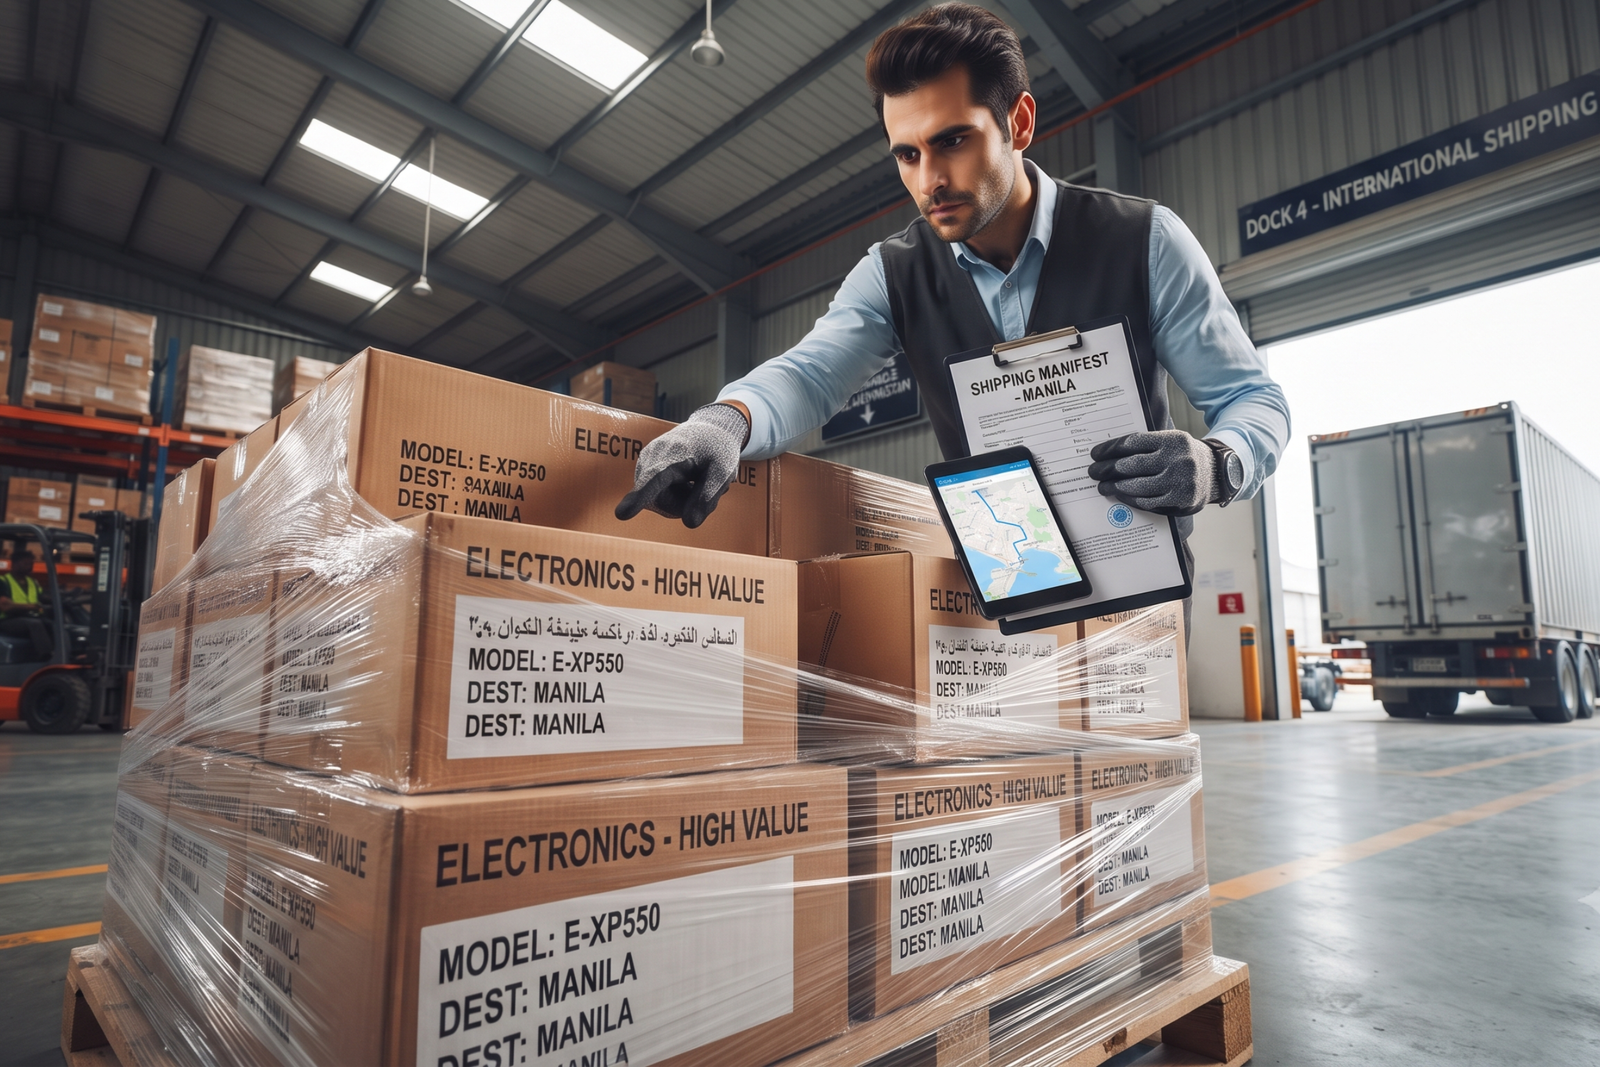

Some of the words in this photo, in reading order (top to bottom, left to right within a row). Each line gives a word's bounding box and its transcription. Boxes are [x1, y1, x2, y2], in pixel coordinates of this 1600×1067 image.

[1245, 204, 1294, 240] DOCK
[1295, 199, 1307, 220] 4
[1322, 138, 1479, 212] INTERNATIONAL
[1483, 91, 1599, 153] SHIPPING
[970, 369, 1035, 396] SHIPPING
[1039, 351, 1109, 381] MANIFEST
[399, 464, 456, 490] DEST:
[400, 439, 474, 470] MODEL:
[479, 454, 546, 482] E-XP550
[465, 498, 522, 523] MANILA
[466, 545, 635, 592] ELECTRONICS
[654, 567, 701, 598] HIGH
[707, 572, 765, 604] VALUE
[468, 647, 546, 672] MODEL:
[552, 651, 624, 673] E-XP550
[936, 660, 971, 676] MODEL:
[467, 680, 527, 704] DEST:
[533, 681, 605, 704] MANILA
[936, 682, 964, 698] DEST:
[465, 713, 526, 738] DEST:
[532, 712, 605, 736] MANILA
[894, 782, 993, 821] ELECTRONICS
[1003, 777, 1031, 804] HIGH
[1032, 774, 1067, 800] VALUE
[330, 829, 367, 879] VALUE
[436, 820, 656, 888] ELECTRONICS
[679, 809, 735, 851] HIGH
[742, 801, 809, 841] VALUE
[900, 843, 946, 870] MODEL:
[1121, 844, 1149, 866] MANILA
[900, 872, 945, 900] MODEL:
[949, 860, 990, 888] MANILA
[1098, 875, 1121, 896] DEST:
[1122, 866, 1150, 888] MANILA
[900, 901, 937, 930] DEST:
[941, 888, 984, 918] MANILA
[268, 920, 300, 966] MANILA
[438, 927, 555, 985] MODEL:
[564, 902, 661, 954] E-XP550
[900, 929, 937, 959] DEST:
[940, 914, 984, 946] MANILA
[439, 981, 528, 1040] DEST:
[539, 951, 638, 1010] MANILA
[537, 997, 634, 1058] MANILA
